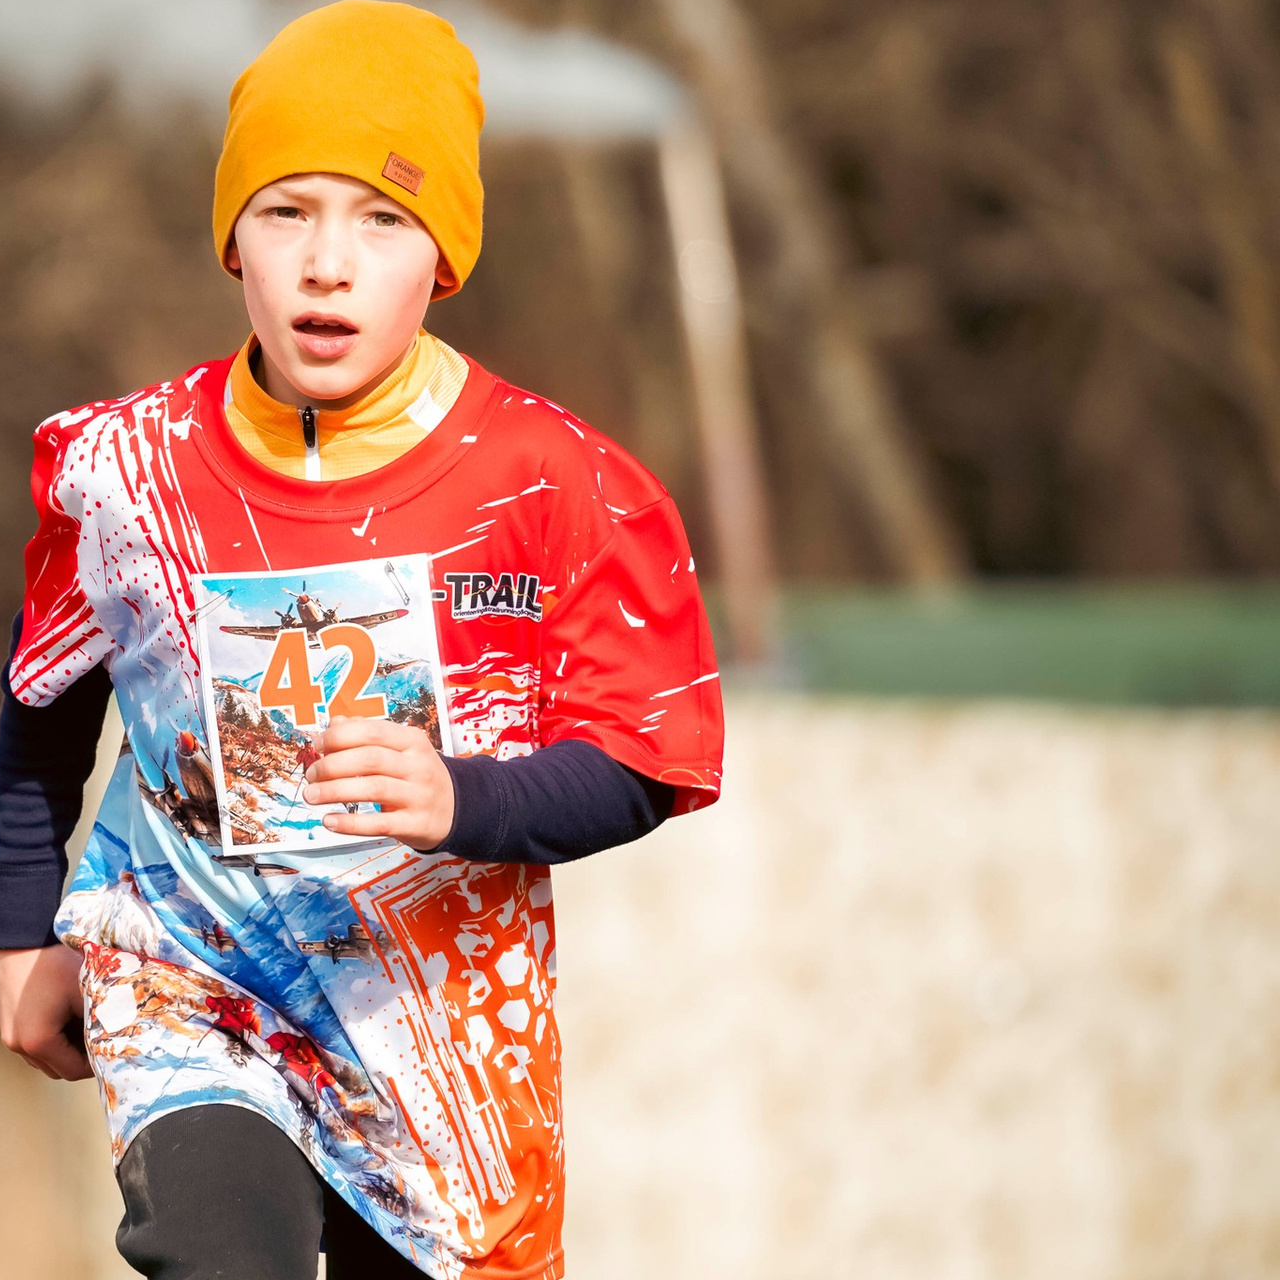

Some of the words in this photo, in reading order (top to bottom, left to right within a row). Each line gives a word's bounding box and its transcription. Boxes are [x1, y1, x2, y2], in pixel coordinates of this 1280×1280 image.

[392, 158, 420, 180] ORANGE
[394, 171, 413, 185] sport
[259, 625, 386, 726] 42
